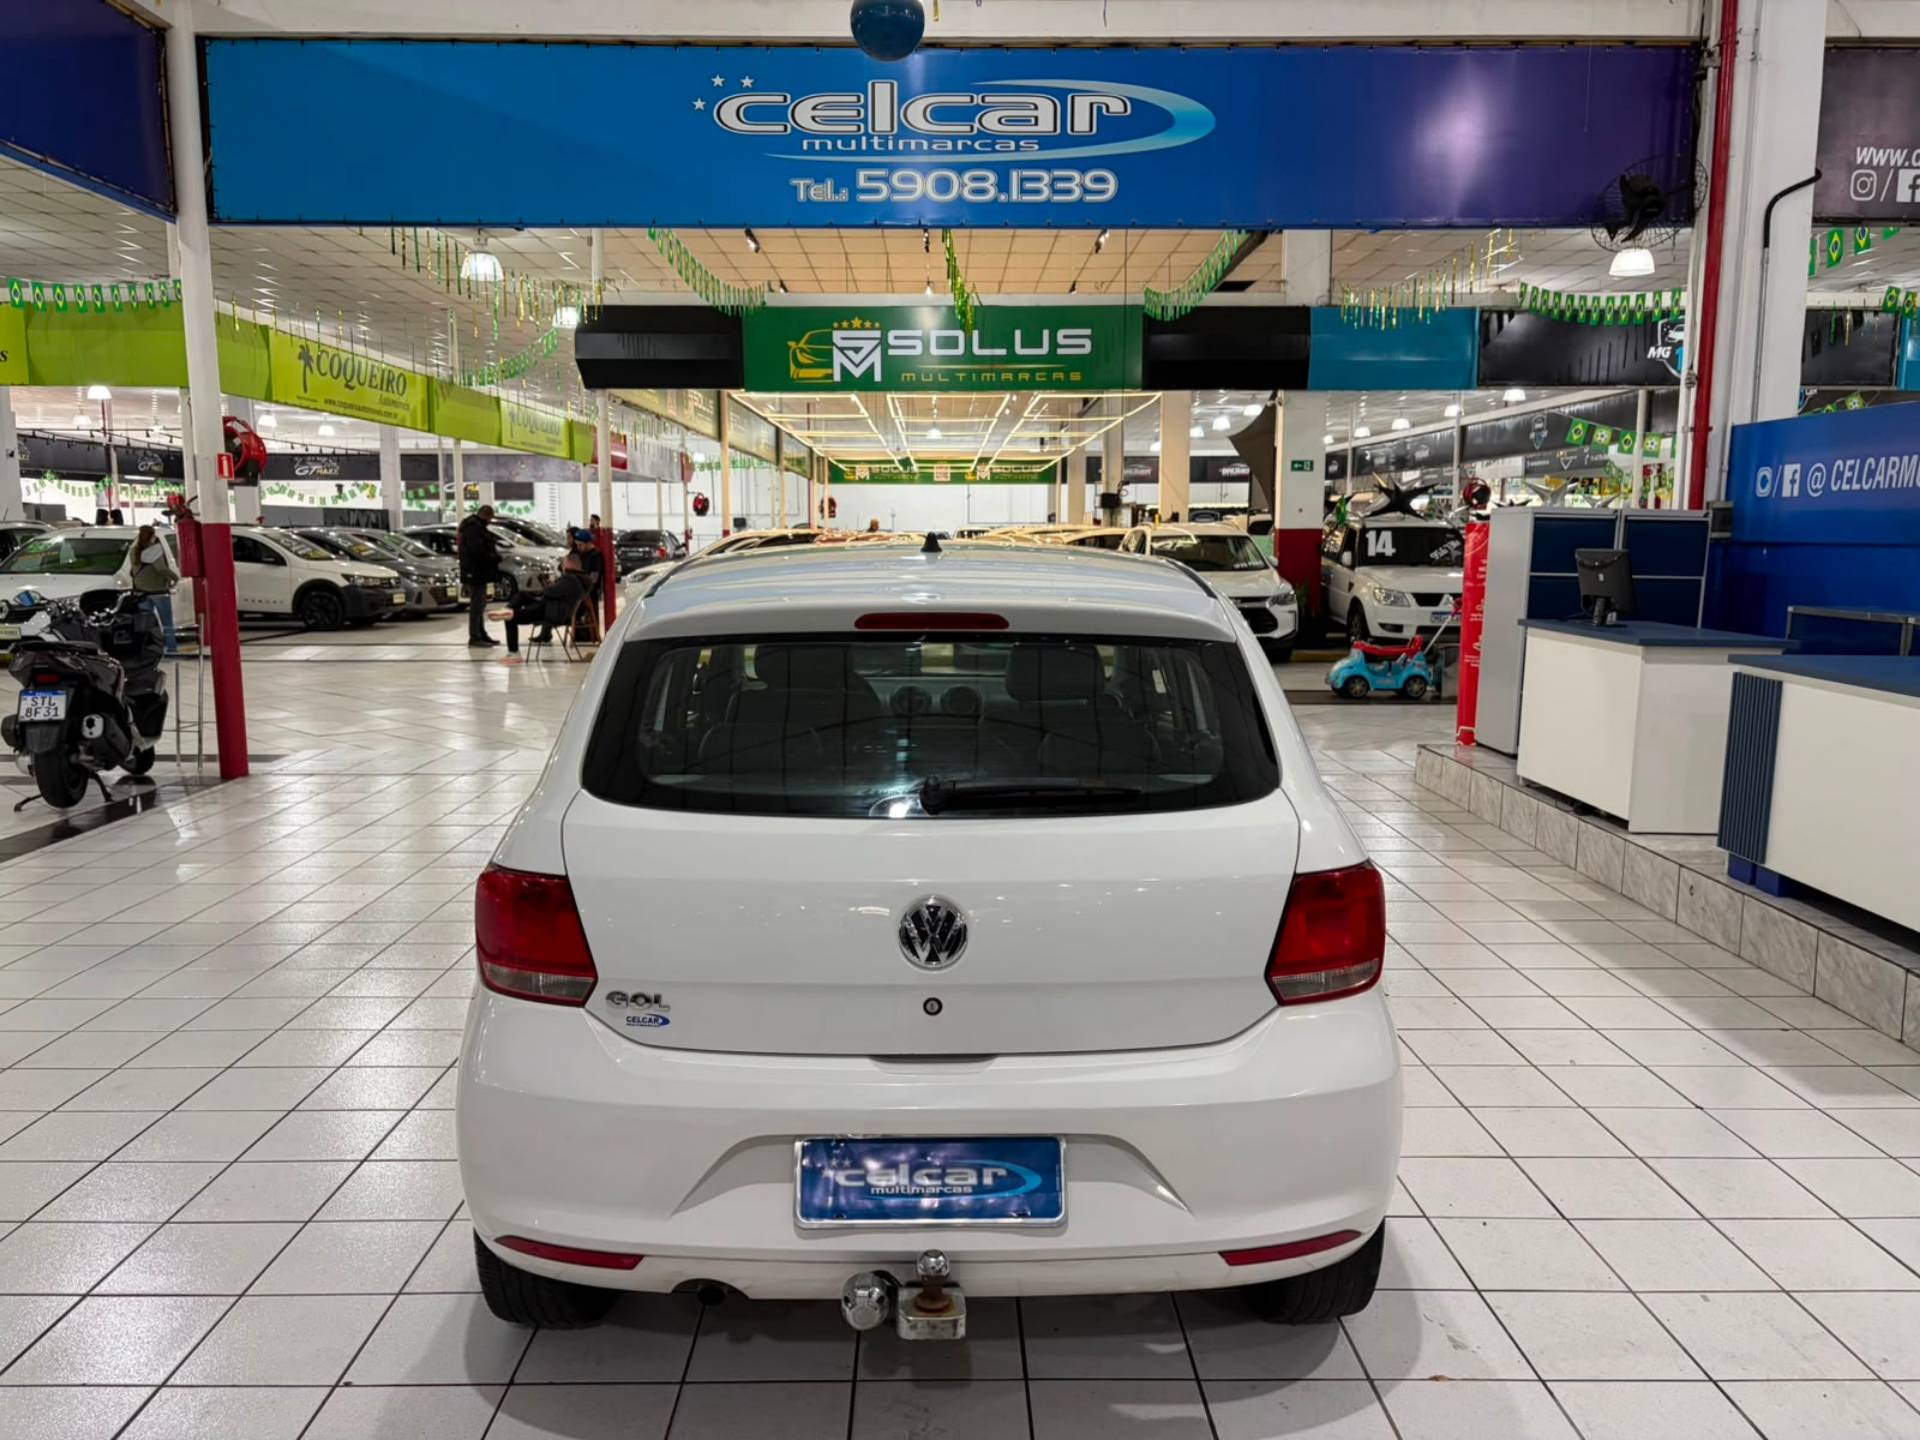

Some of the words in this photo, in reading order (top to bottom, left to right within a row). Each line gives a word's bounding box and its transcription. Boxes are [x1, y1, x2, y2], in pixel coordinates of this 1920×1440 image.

[714, 79, 1131, 135] celcar
[802, 136, 1040, 151] multimarcas
[855, 168, 1119, 202] 5908.1339
[887, 328, 1093, 356] SOLUS
[1646, 346, 1673, 360] MG
[316, 350, 408, 397] COQUEIRO
[901, 371, 1083, 382] MULTIMARCAS
[1830, 454, 1920, 492] CELCARM
[1366, 530, 1397, 557] 14
[25, 706, 60, 718] 8F31
[31, 696, 56, 707] STL
[605, 990, 671, 1012] GOL
[835, 1163, 1008, 1187] celcar
[870, 1184, 973, 1195] multimarcas
